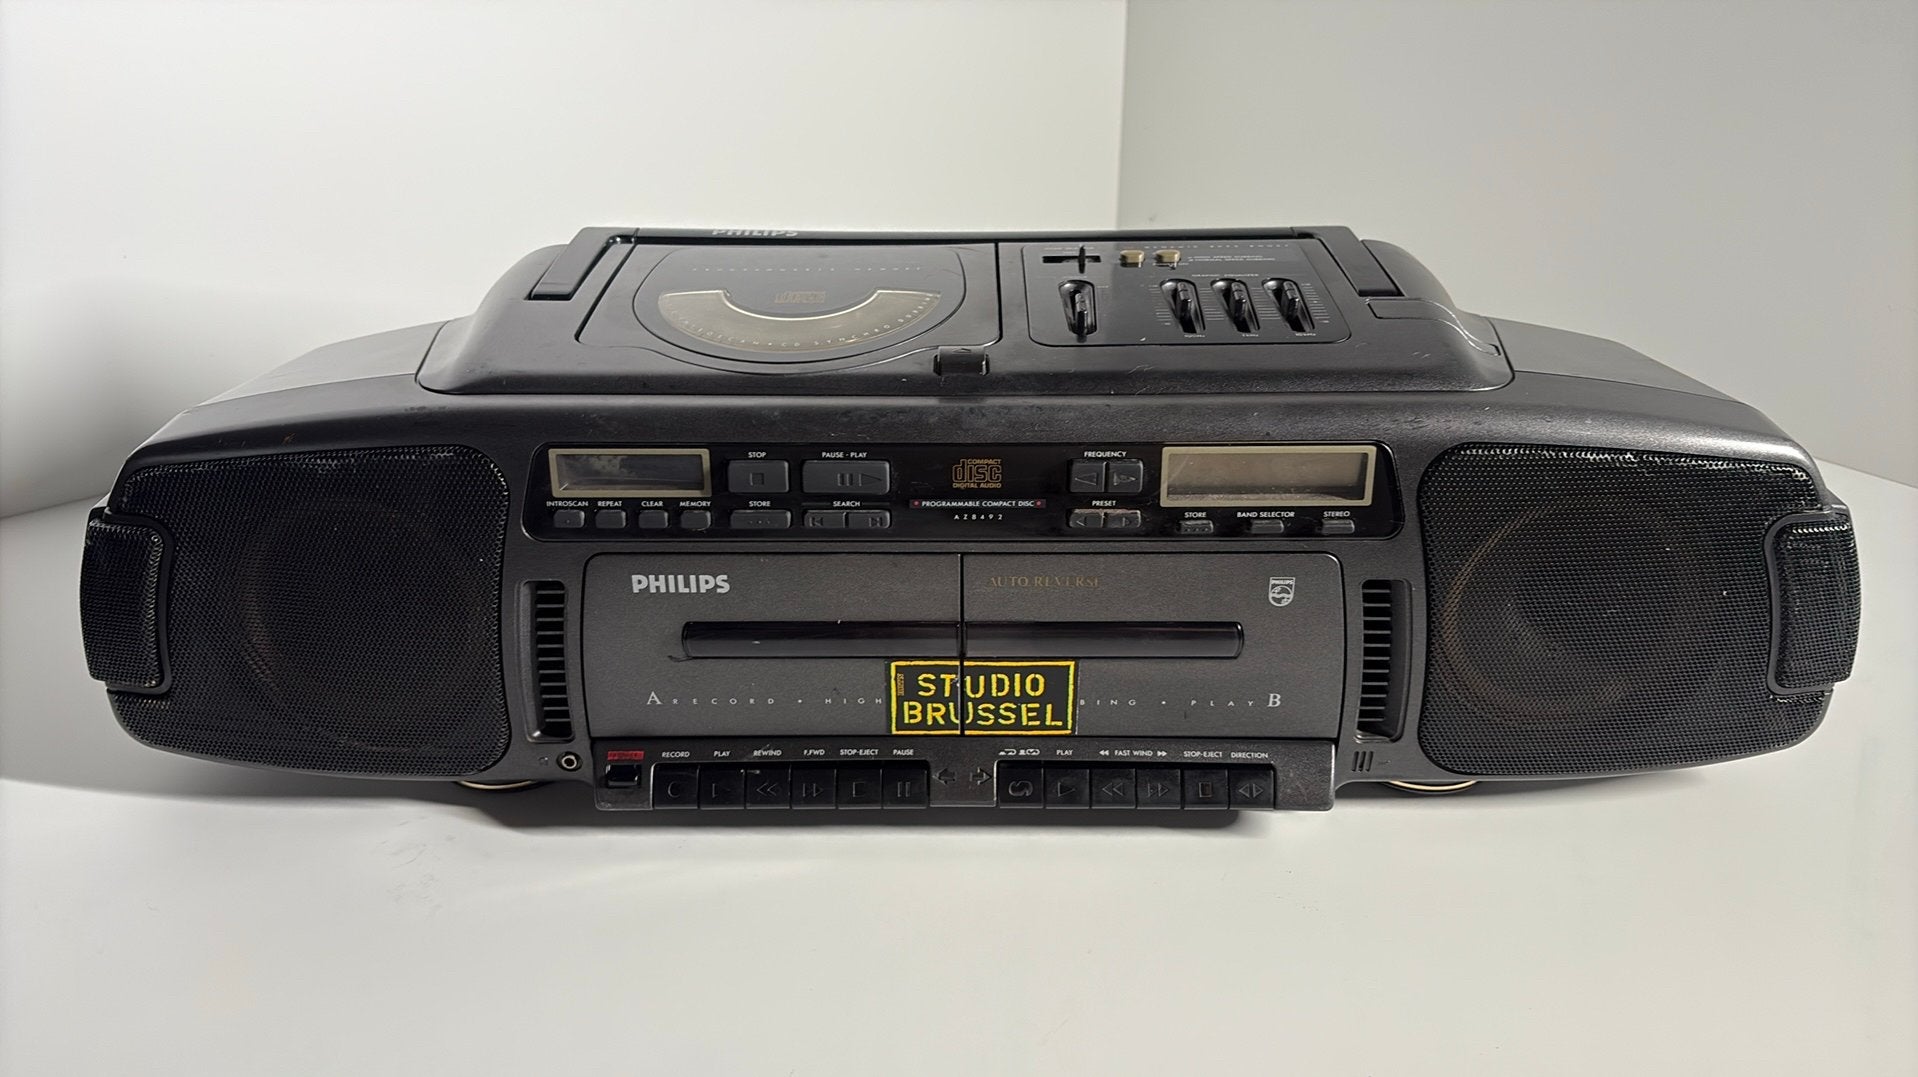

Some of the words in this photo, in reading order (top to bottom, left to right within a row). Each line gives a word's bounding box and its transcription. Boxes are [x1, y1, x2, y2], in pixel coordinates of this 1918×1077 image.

[712, 229, 799, 238] PHILIPS
[747, 451, 767, 459] STOP
[821, 451, 844, 459] PAUSE
[849, 451, 868, 459] PLAY
[1083, 450, 1127, 458] FREQUENCY
[748, 500, 771, 508] STORE
[832, 500, 861, 508] SEARCH
[921, 500, 980, 508] PROGRAMMABLE
[1184, 511, 1207, 519] STORE
[1323, 510, 1351, 518] STEREO
[632, 575, 730, 593] PHILIPS
[917, 672, 1045, 698] STUDIO
[672, 697, 775, 705] RECORD
[824, 697, 882, 705] HIGH
[1190, 699, 1254, 707] PLAY
[1268, 694, 1281, 707] B
[902, 700, 1064, 727] BRUSSEL
[661, 750, 691, 759] RECORD
[752, 749, 782, 757] REWIND
[839, 748, 879, 756] STOP-EJECT
[892, 748, 914, 756] PAUSE
[1114, 749, 1131, 757] FAST
[1183, 750, 1223, 758] STOP-EJECT
[1230, 751, 1269, 759] DIRECTION
